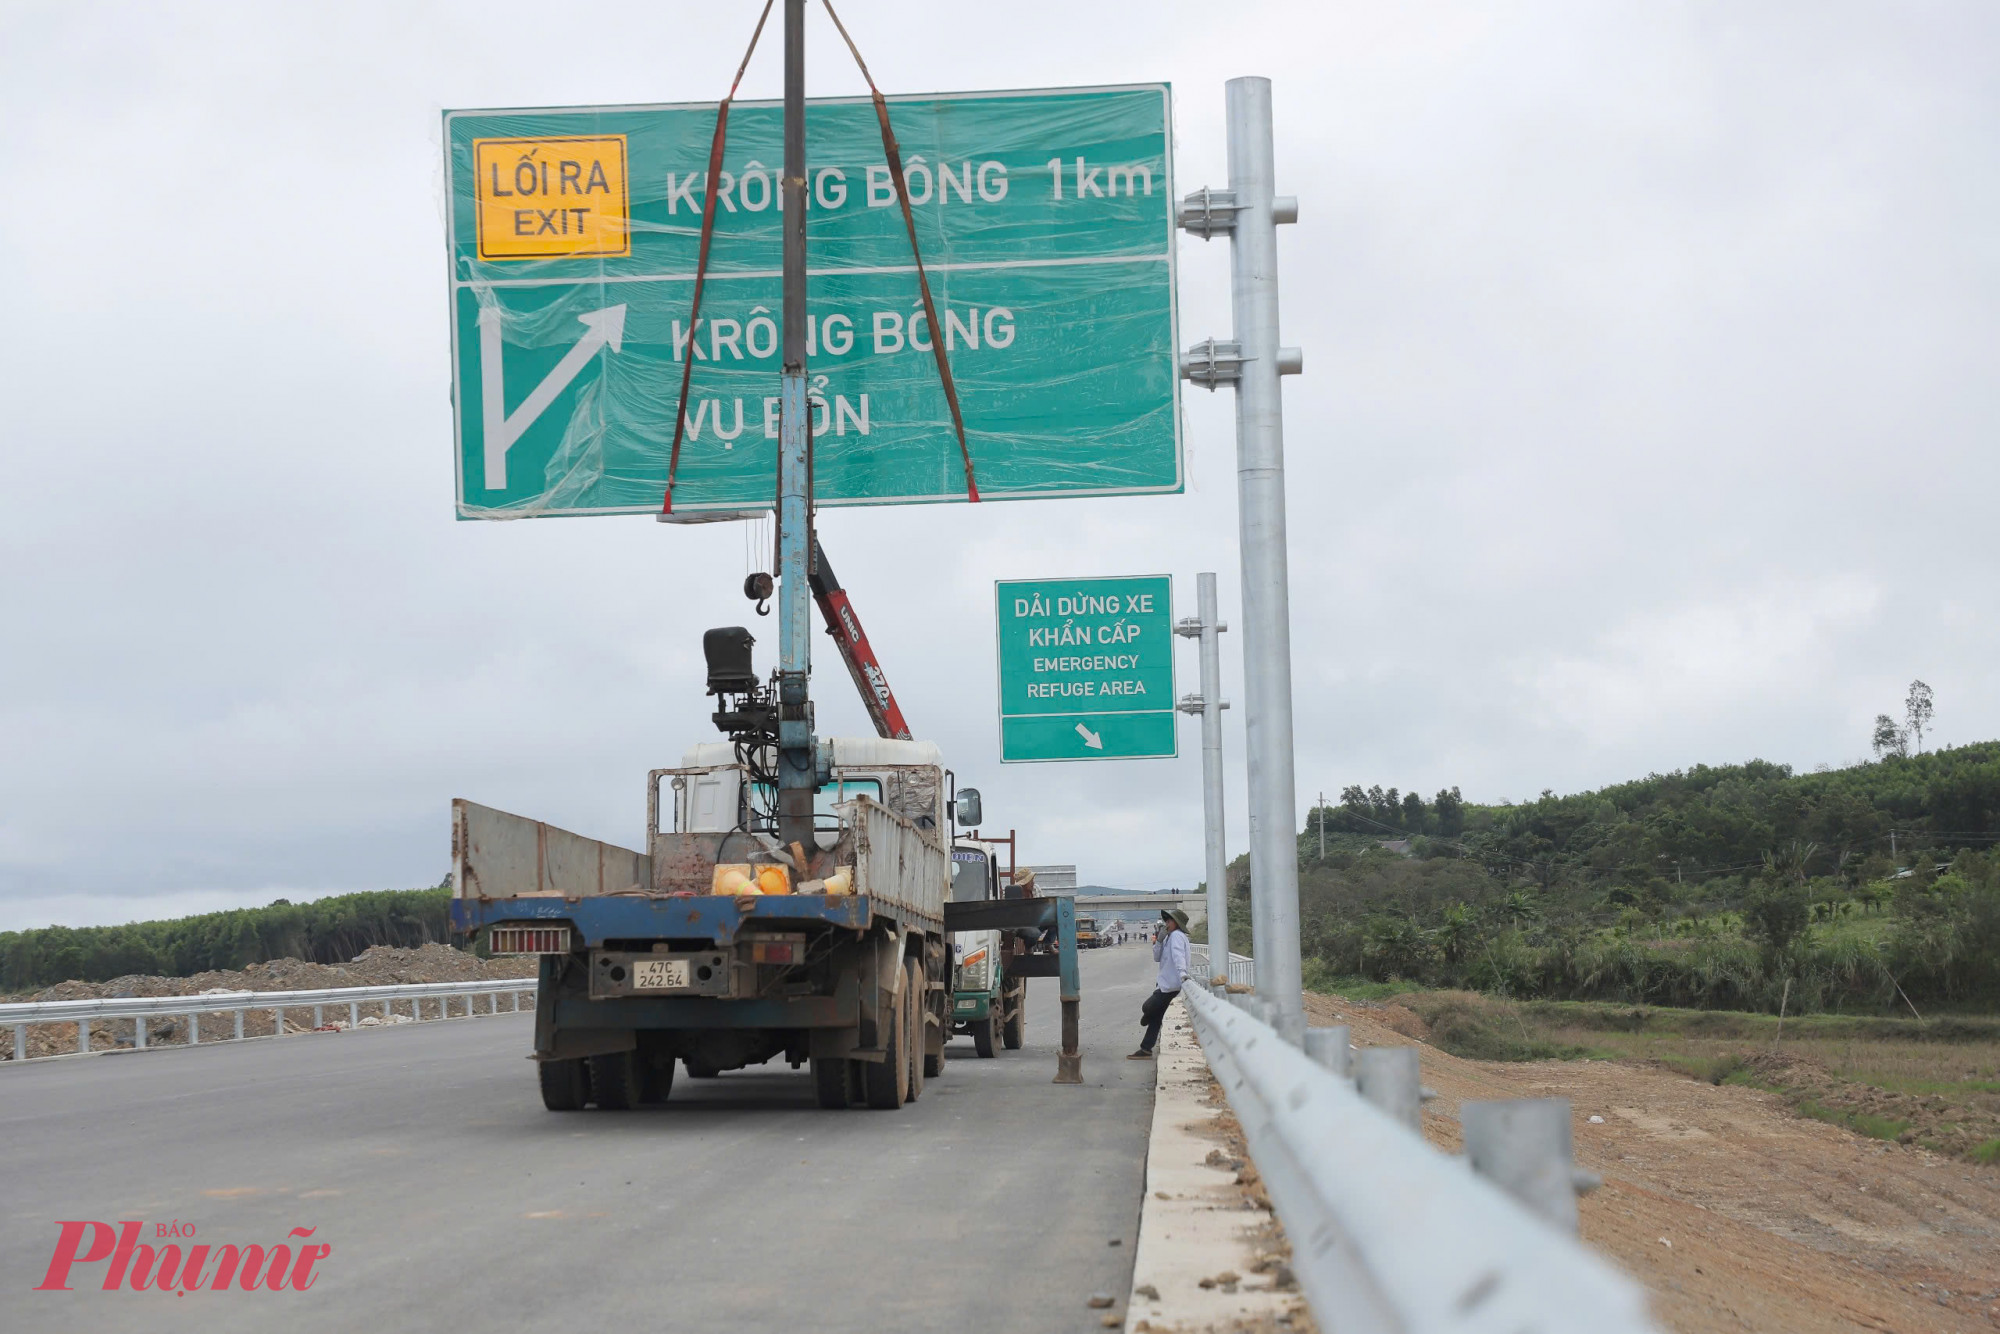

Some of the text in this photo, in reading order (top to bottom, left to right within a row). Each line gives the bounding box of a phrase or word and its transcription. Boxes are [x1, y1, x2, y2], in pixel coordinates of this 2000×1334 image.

[492, 148, 610, 197] LỐI RA
[866, 154, 1009, 207] BÔNG
[515, 208, 591, 236] EXIT
[675, 398, 744, 450] VỤ
[1015, 591, 1154, 617] DẢI DỪNG XE
[840, 605, 860, 643] UNIC
[1029, 618, 1141, 647] KHẨN CẤP
[1033, 655, 1139, 672] EMERGENCY
[1027, 680, 1146, 698] REFUGE AREA
[640, 975, 682, 987] 242.64
[649, 962, 673, 974] 47C
